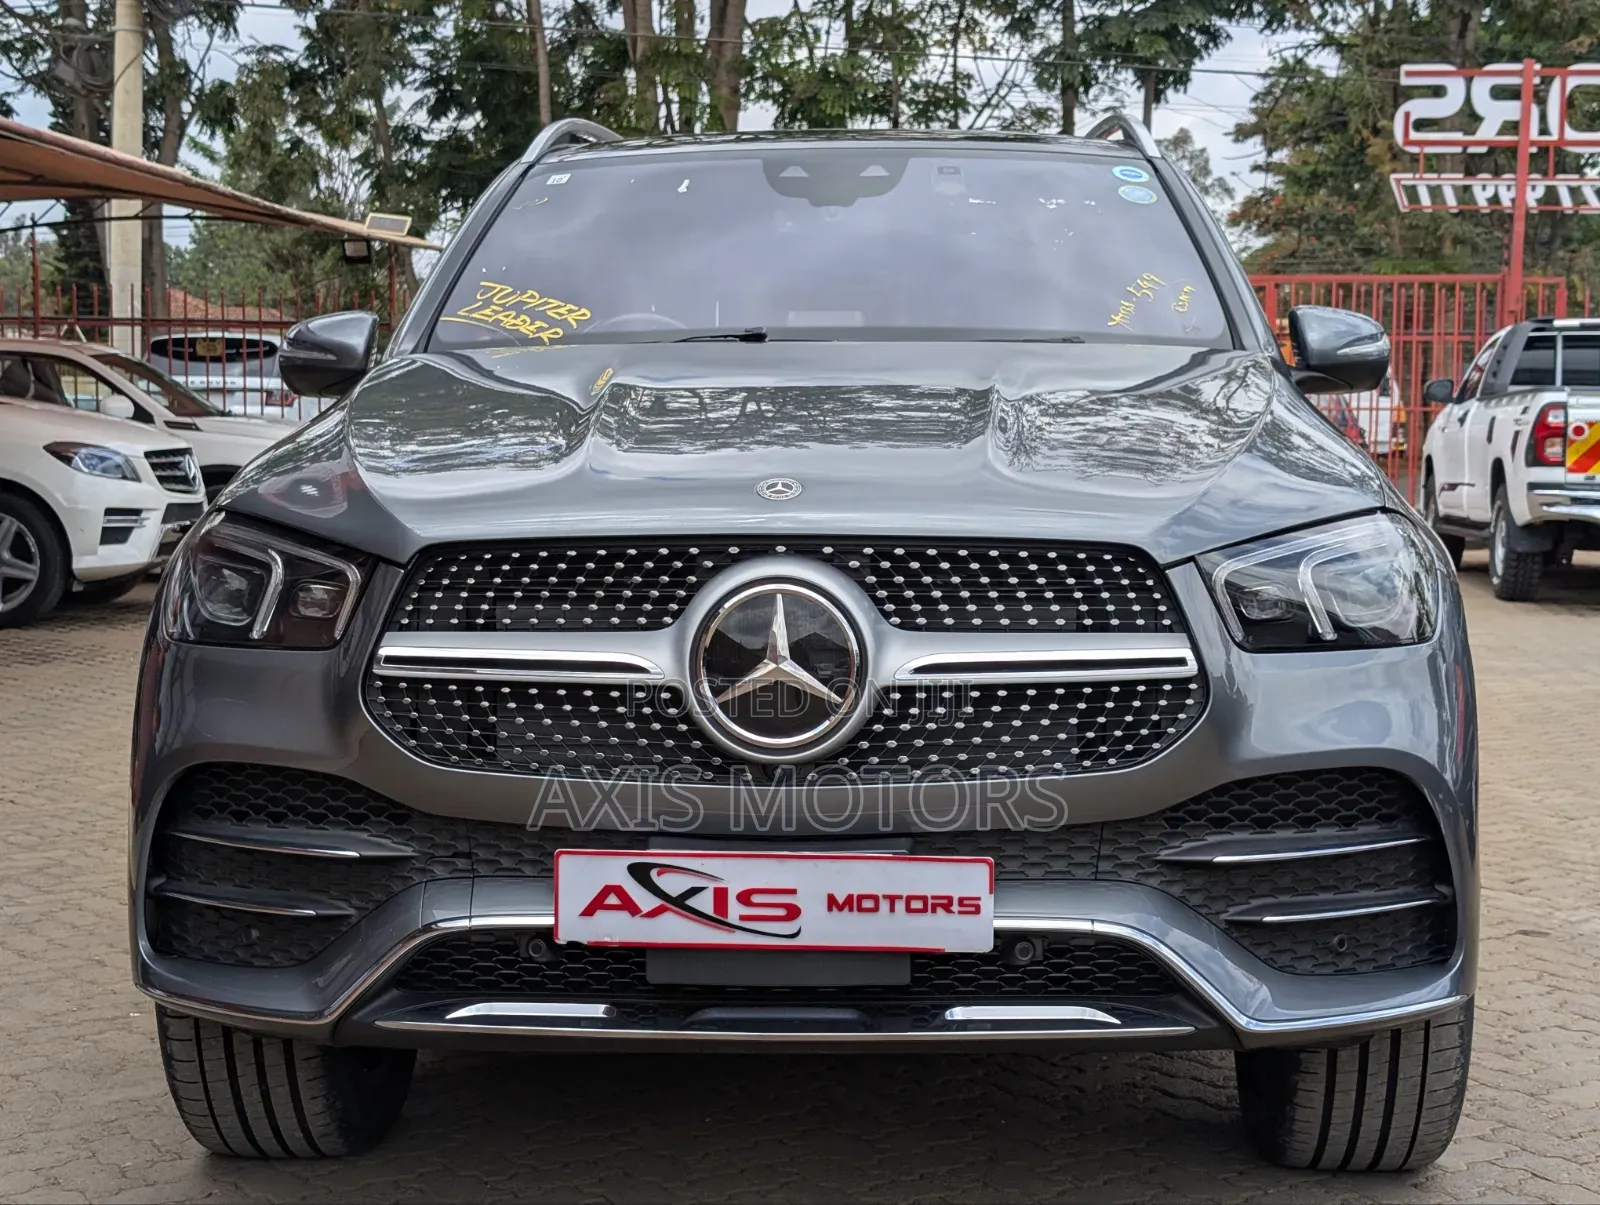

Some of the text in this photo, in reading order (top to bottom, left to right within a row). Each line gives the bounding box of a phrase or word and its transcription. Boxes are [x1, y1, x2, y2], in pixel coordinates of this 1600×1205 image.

[457, 301, 564, 345] LEADER
[477, 281, 592, 329] JUPITER
[578, 876, 981, 926] AXIS MOTORS
